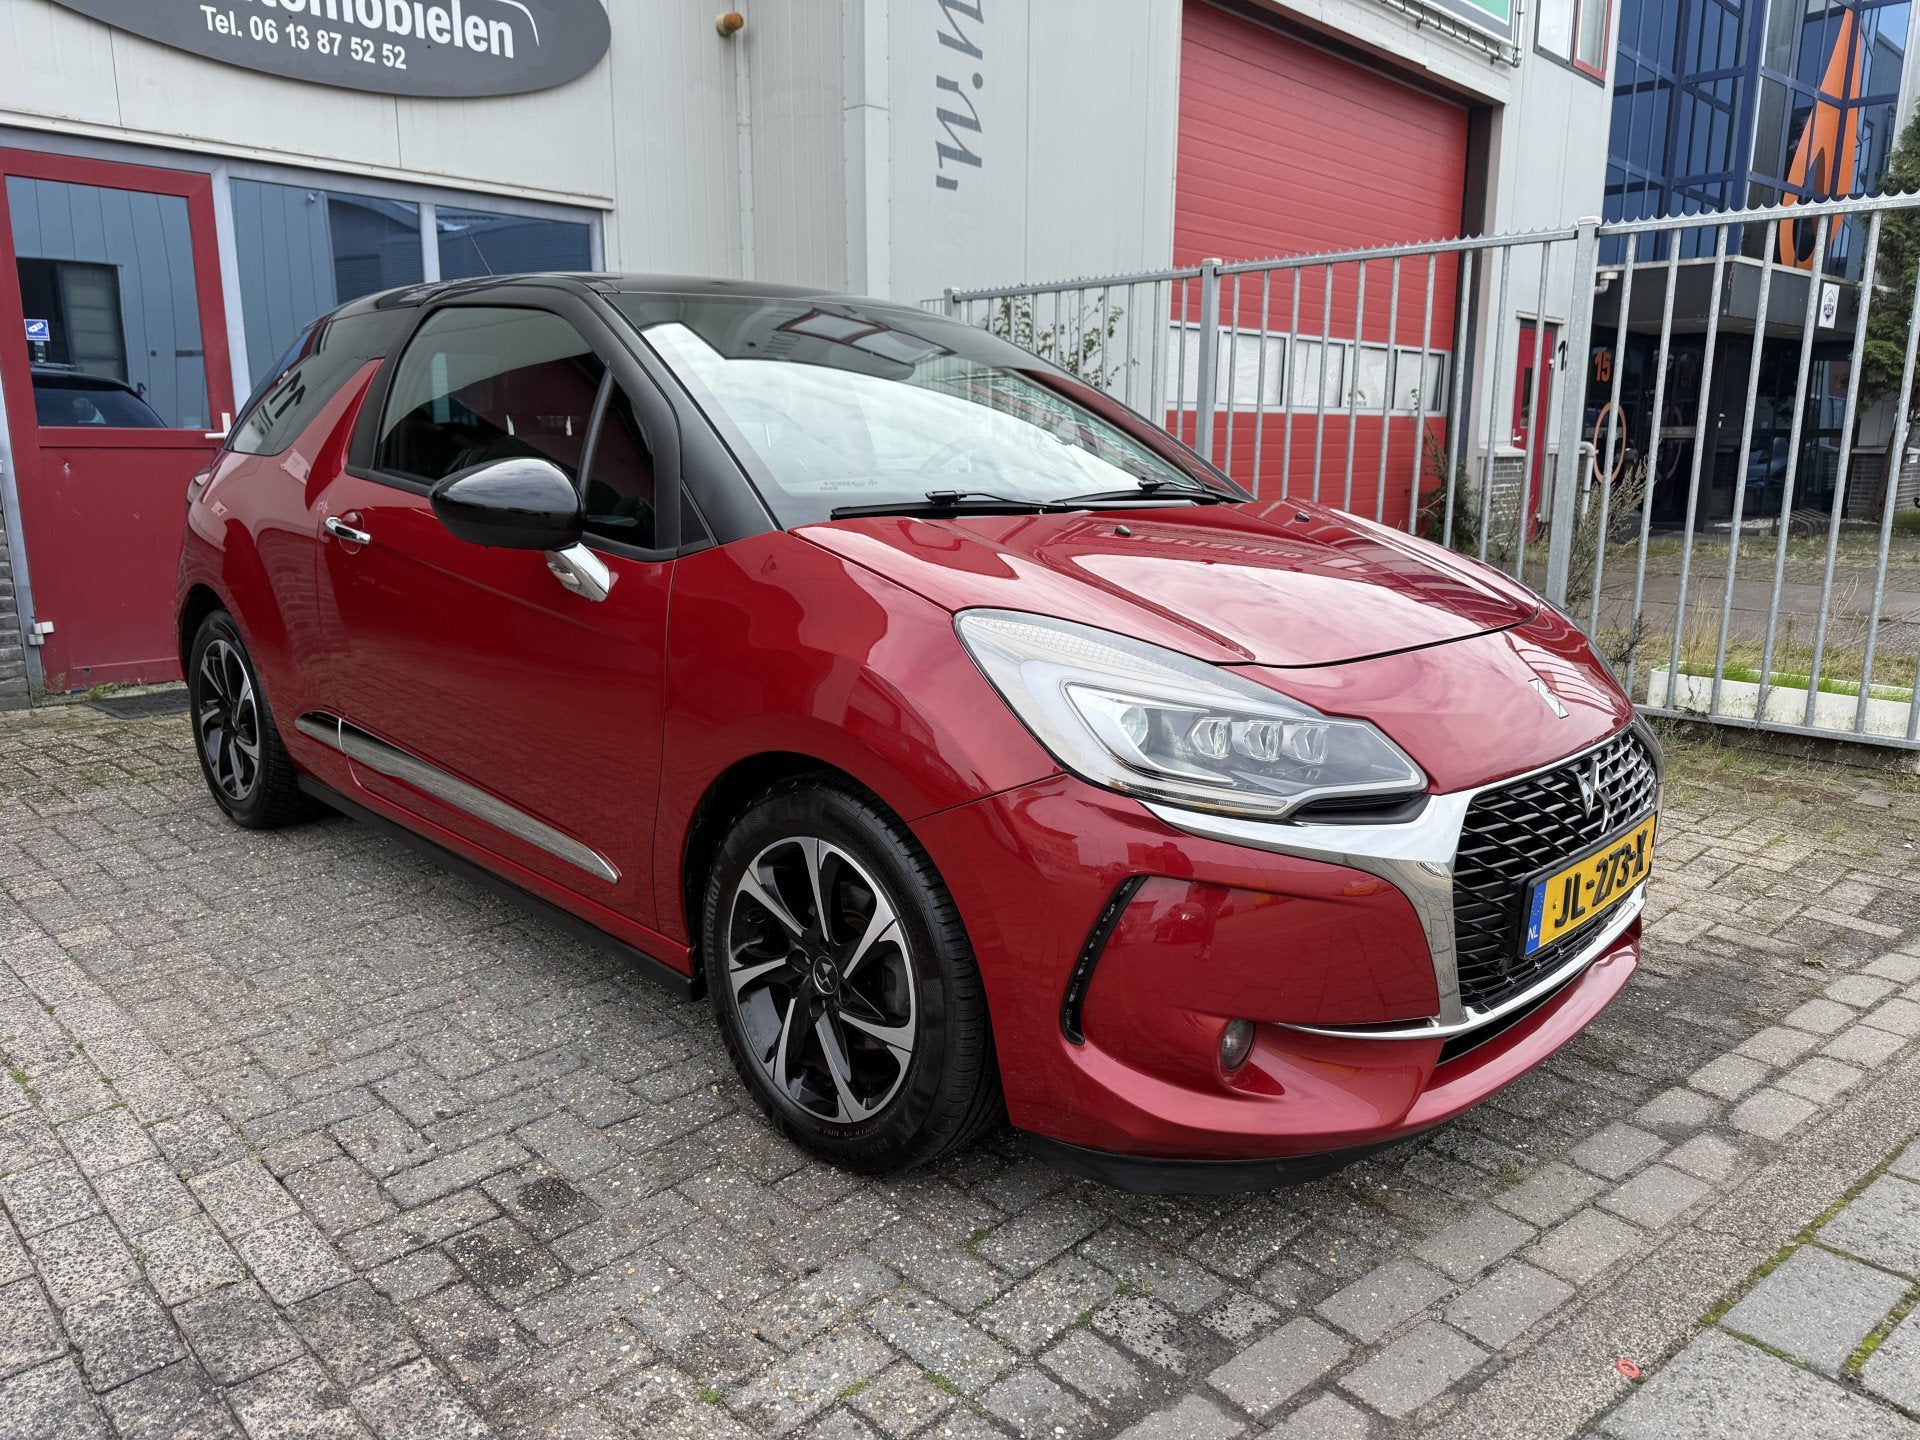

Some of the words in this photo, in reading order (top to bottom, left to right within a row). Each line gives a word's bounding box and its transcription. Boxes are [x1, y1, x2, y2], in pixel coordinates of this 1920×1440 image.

[200, 5, 242, 37] Tel.
[250, 16, 278, 43] 06
[286, 24, 310, 50] 13
[317, 29, 342, 56] 87
[350, 37, 376, 63] 52
[382, 44, 407, 69] 52
[1594, 351, 1612, 382] 15
[1554, 829, 1649, 928] JL-273-X
[1527, 924, 1538, 942] NL
